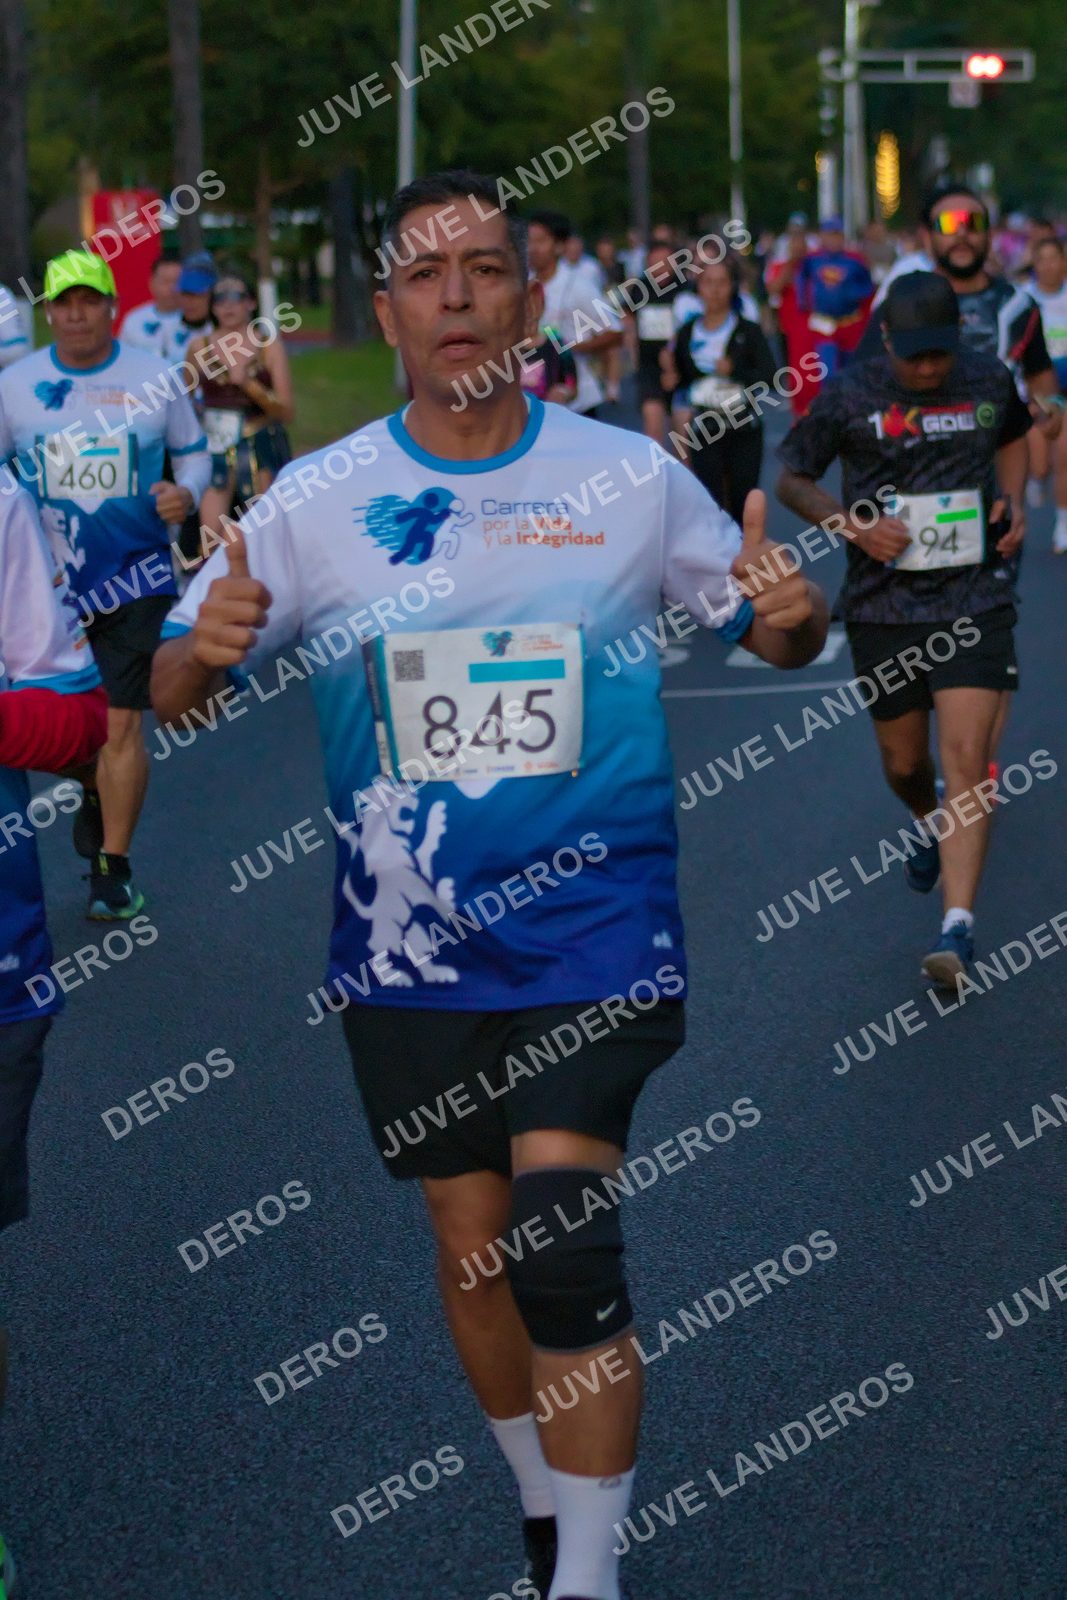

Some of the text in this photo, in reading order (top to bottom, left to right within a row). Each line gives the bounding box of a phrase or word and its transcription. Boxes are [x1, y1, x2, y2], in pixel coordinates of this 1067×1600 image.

[59, 461, 117, 490] 460
[481, 499, 569, 516] Carrera
[483, 519, 509, 534] por
[515, 517, 529, 530] la
[499, 533, 512, 545] la
[516, 531, 606, 549] Integridad
[919, 525, 959, 558] 94
[422, 688, 557, 759] 845
